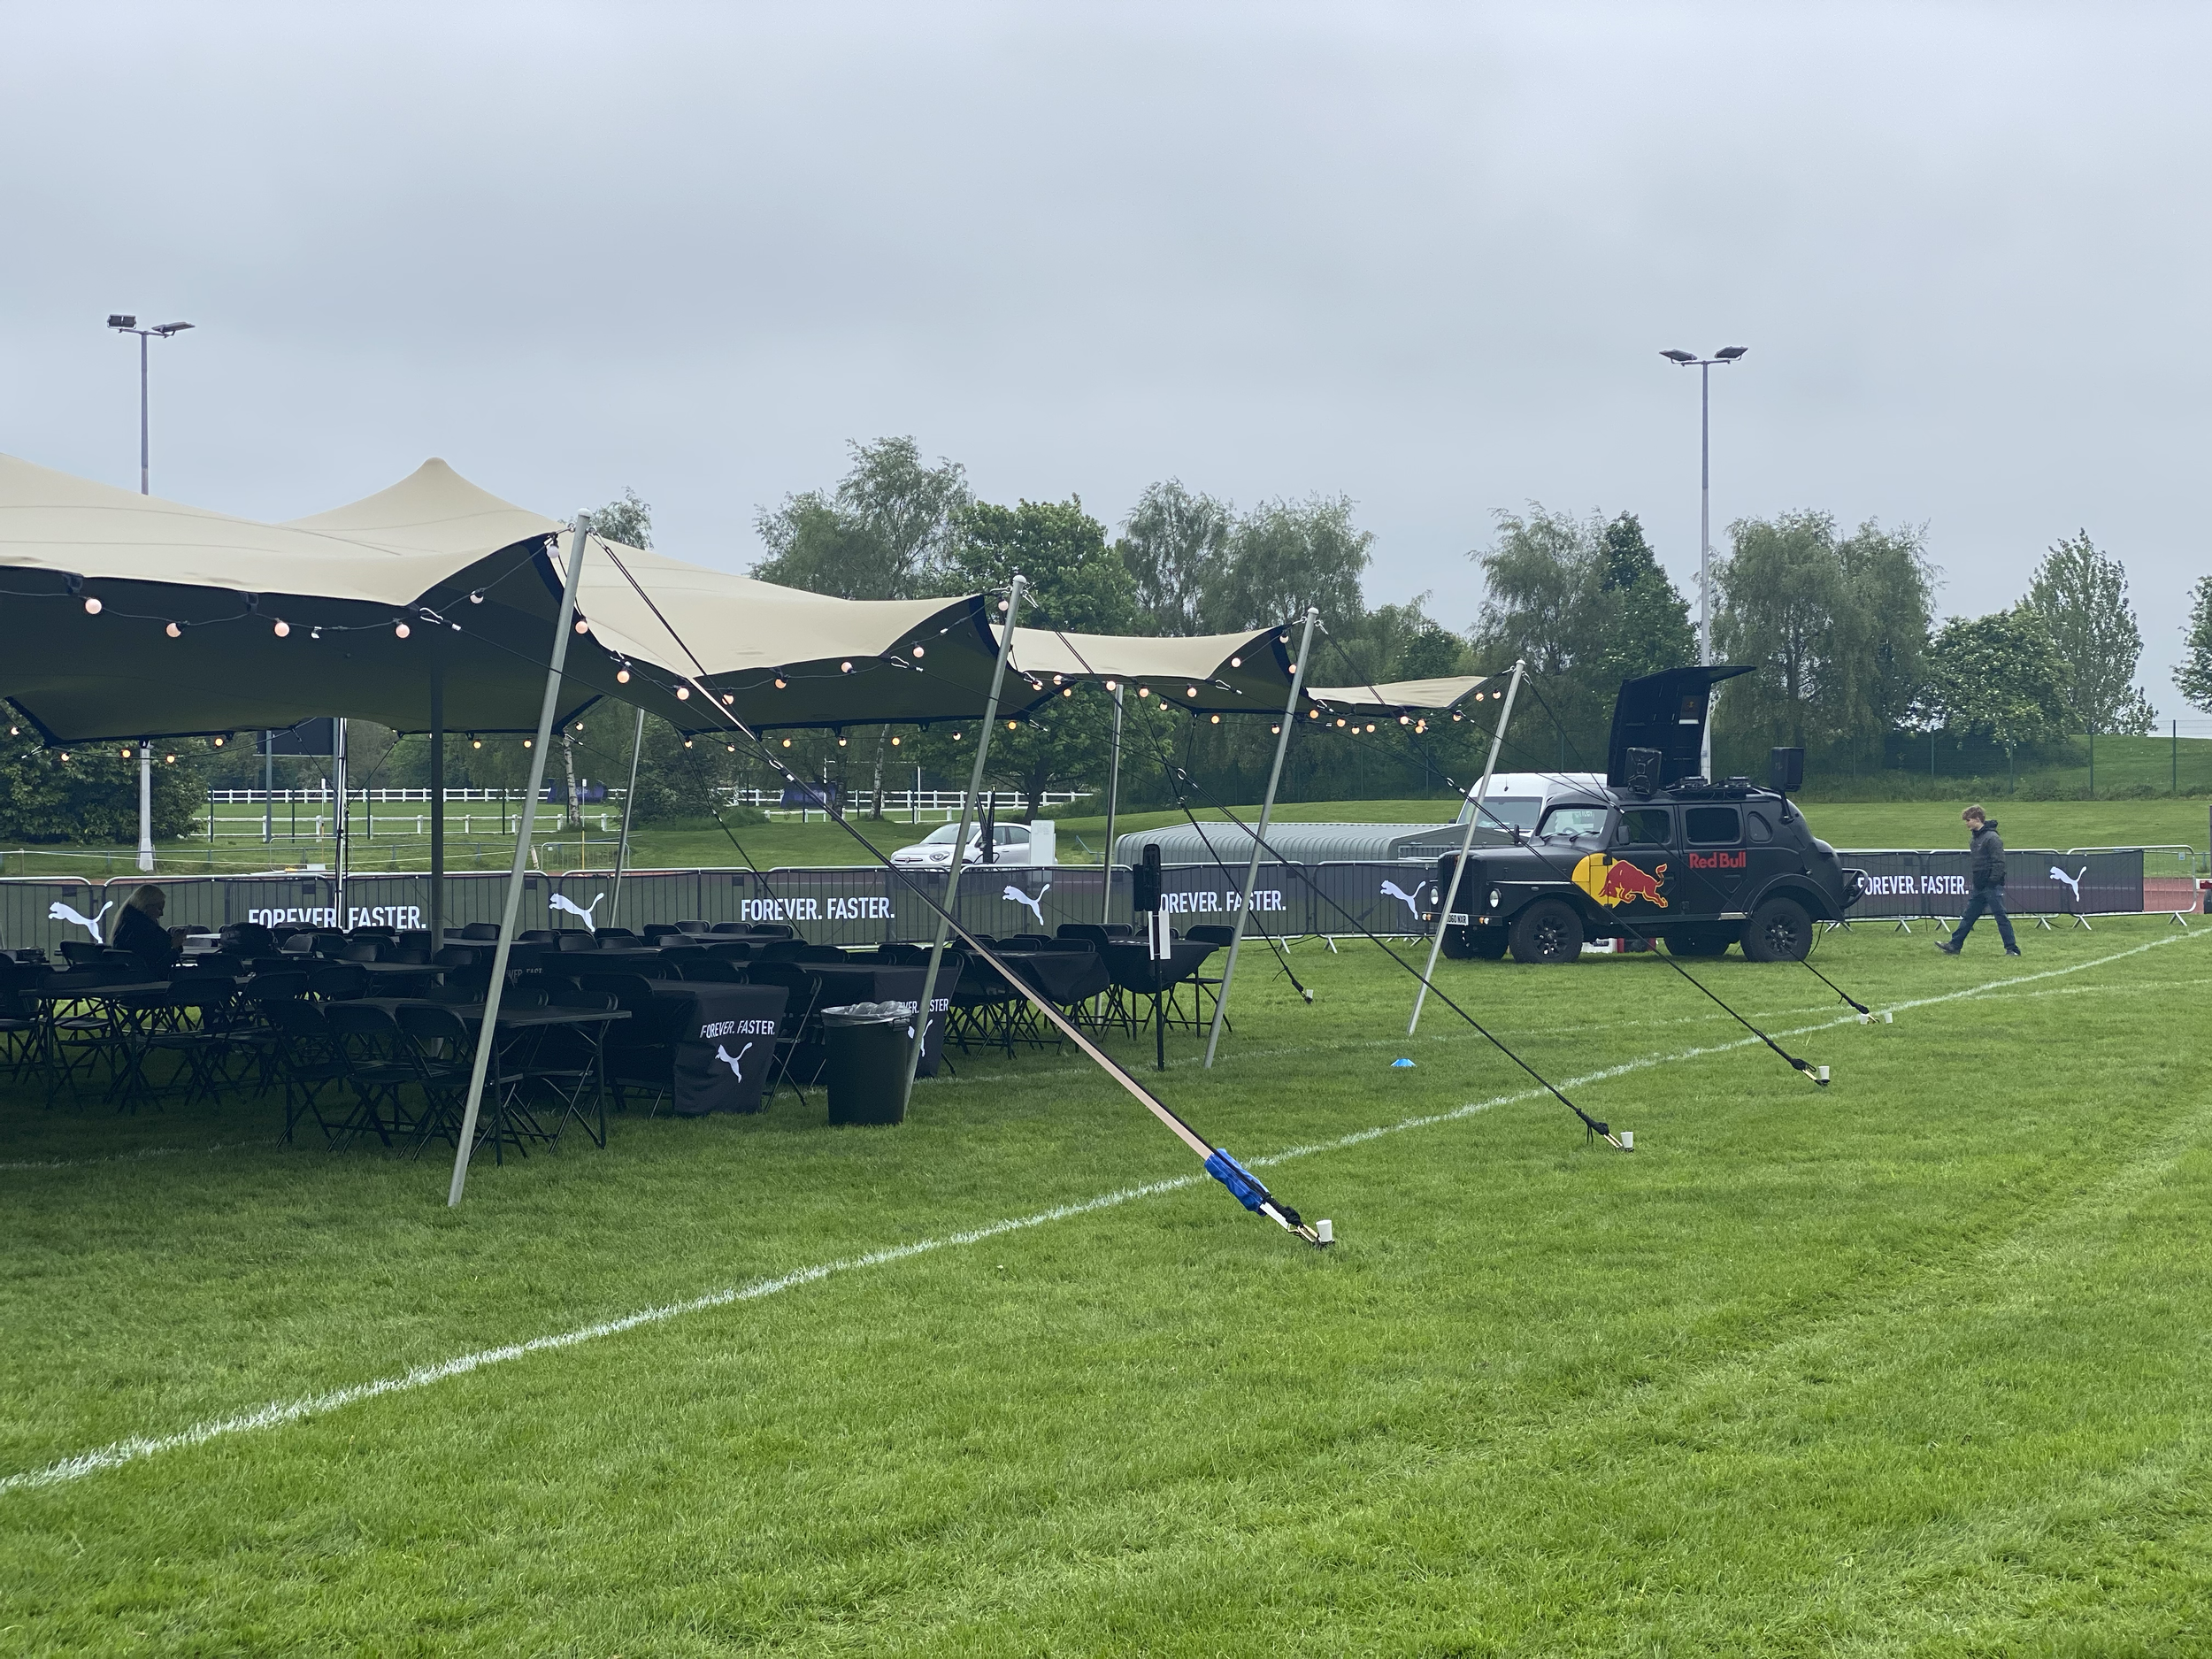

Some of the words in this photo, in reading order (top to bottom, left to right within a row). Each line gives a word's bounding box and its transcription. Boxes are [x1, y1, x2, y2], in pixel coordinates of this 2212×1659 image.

[1689, 853, 1717, 868] Red
[1719, 850, 1746, 868] Bull
[1921, 875, 1969, 895] FASTER.
[741, 898, 822, 921] FOREVER.
[827, 896, 895, 919] FASTER.
[1160, 891, 1222, 913] OREVER.
[349, 905, 426, 929] FASTER.
[699, 1021, 734, 1039] FOREVER.
